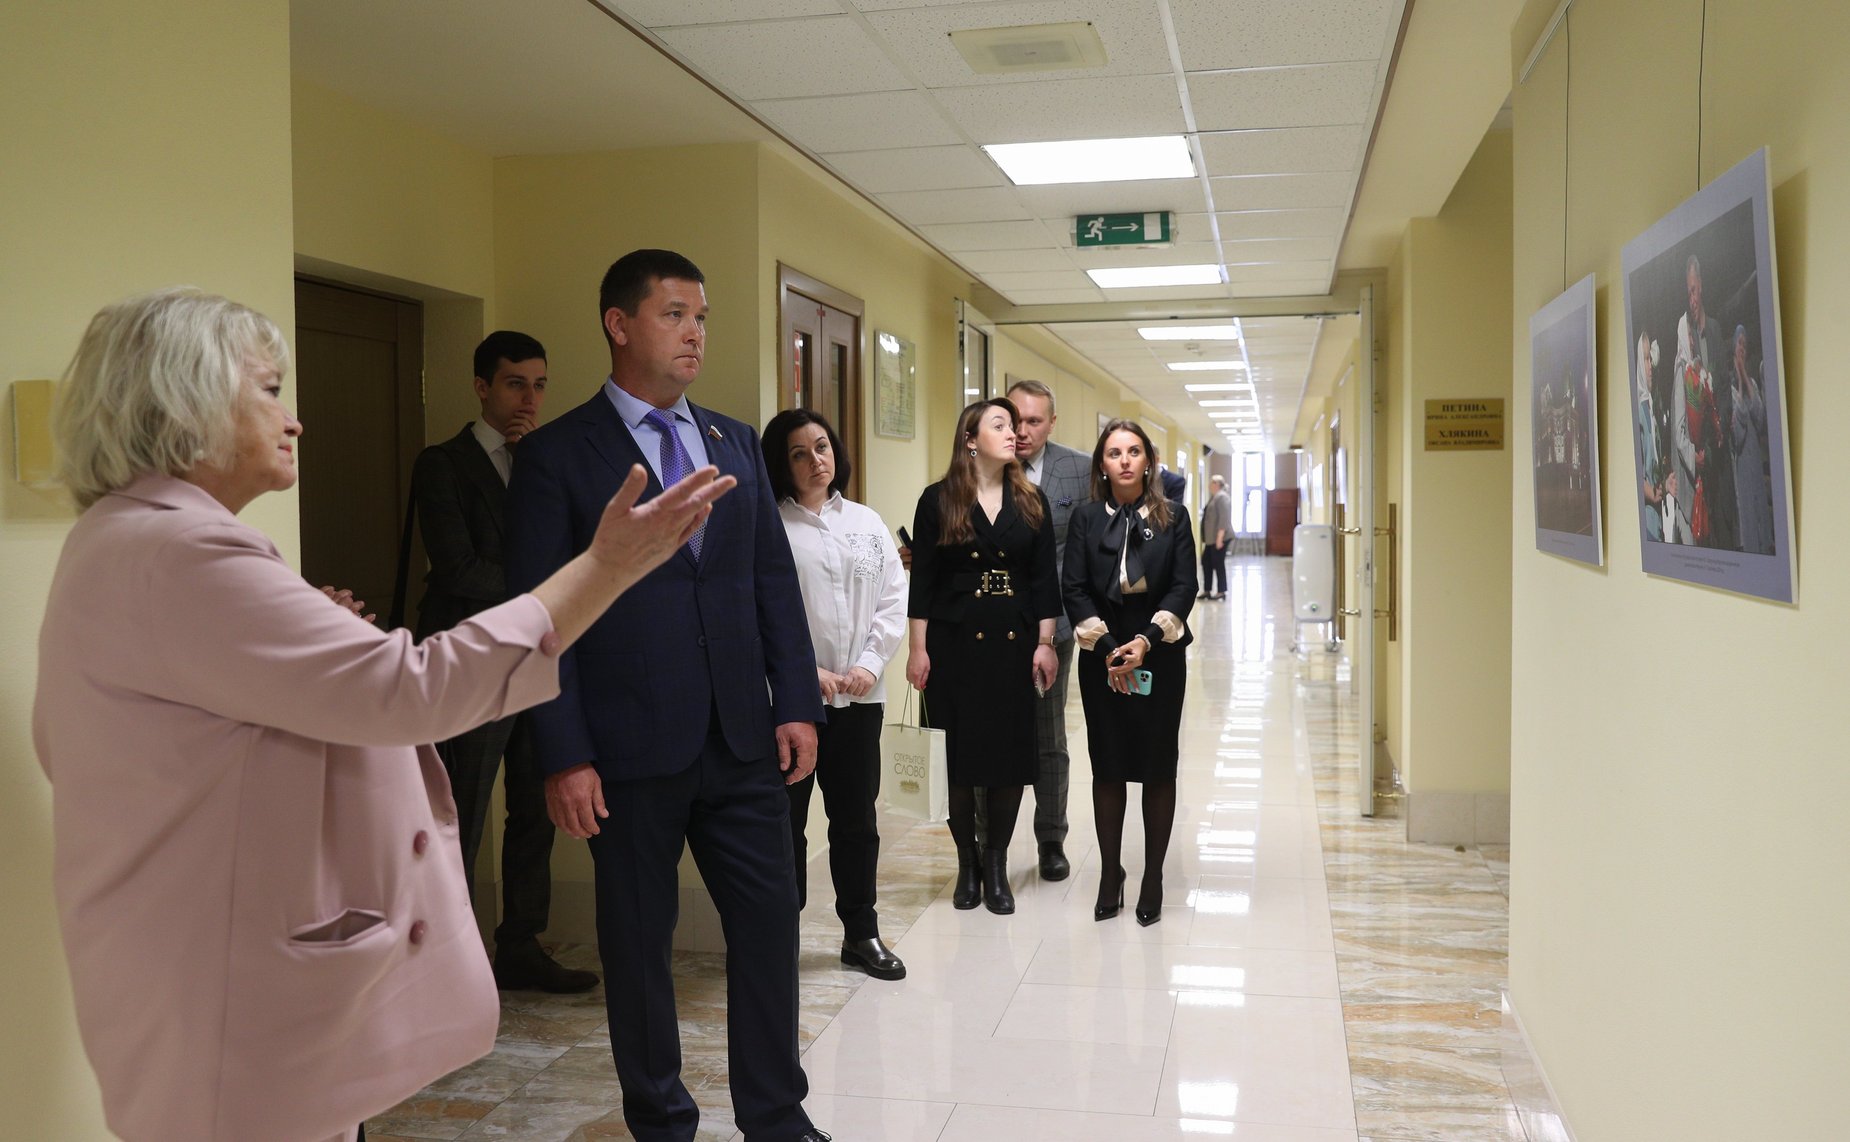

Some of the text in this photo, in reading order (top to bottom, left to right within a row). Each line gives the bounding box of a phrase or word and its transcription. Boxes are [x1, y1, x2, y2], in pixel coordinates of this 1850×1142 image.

[1442, 404, 1487, 412] ПЕТИНА
[1439, 430, 1489, 438] ХЛЯКИНА
[894, 752, 926, 766] ОТКРЫТОЕ
[894, 763, 926, 778] СЛОВО
